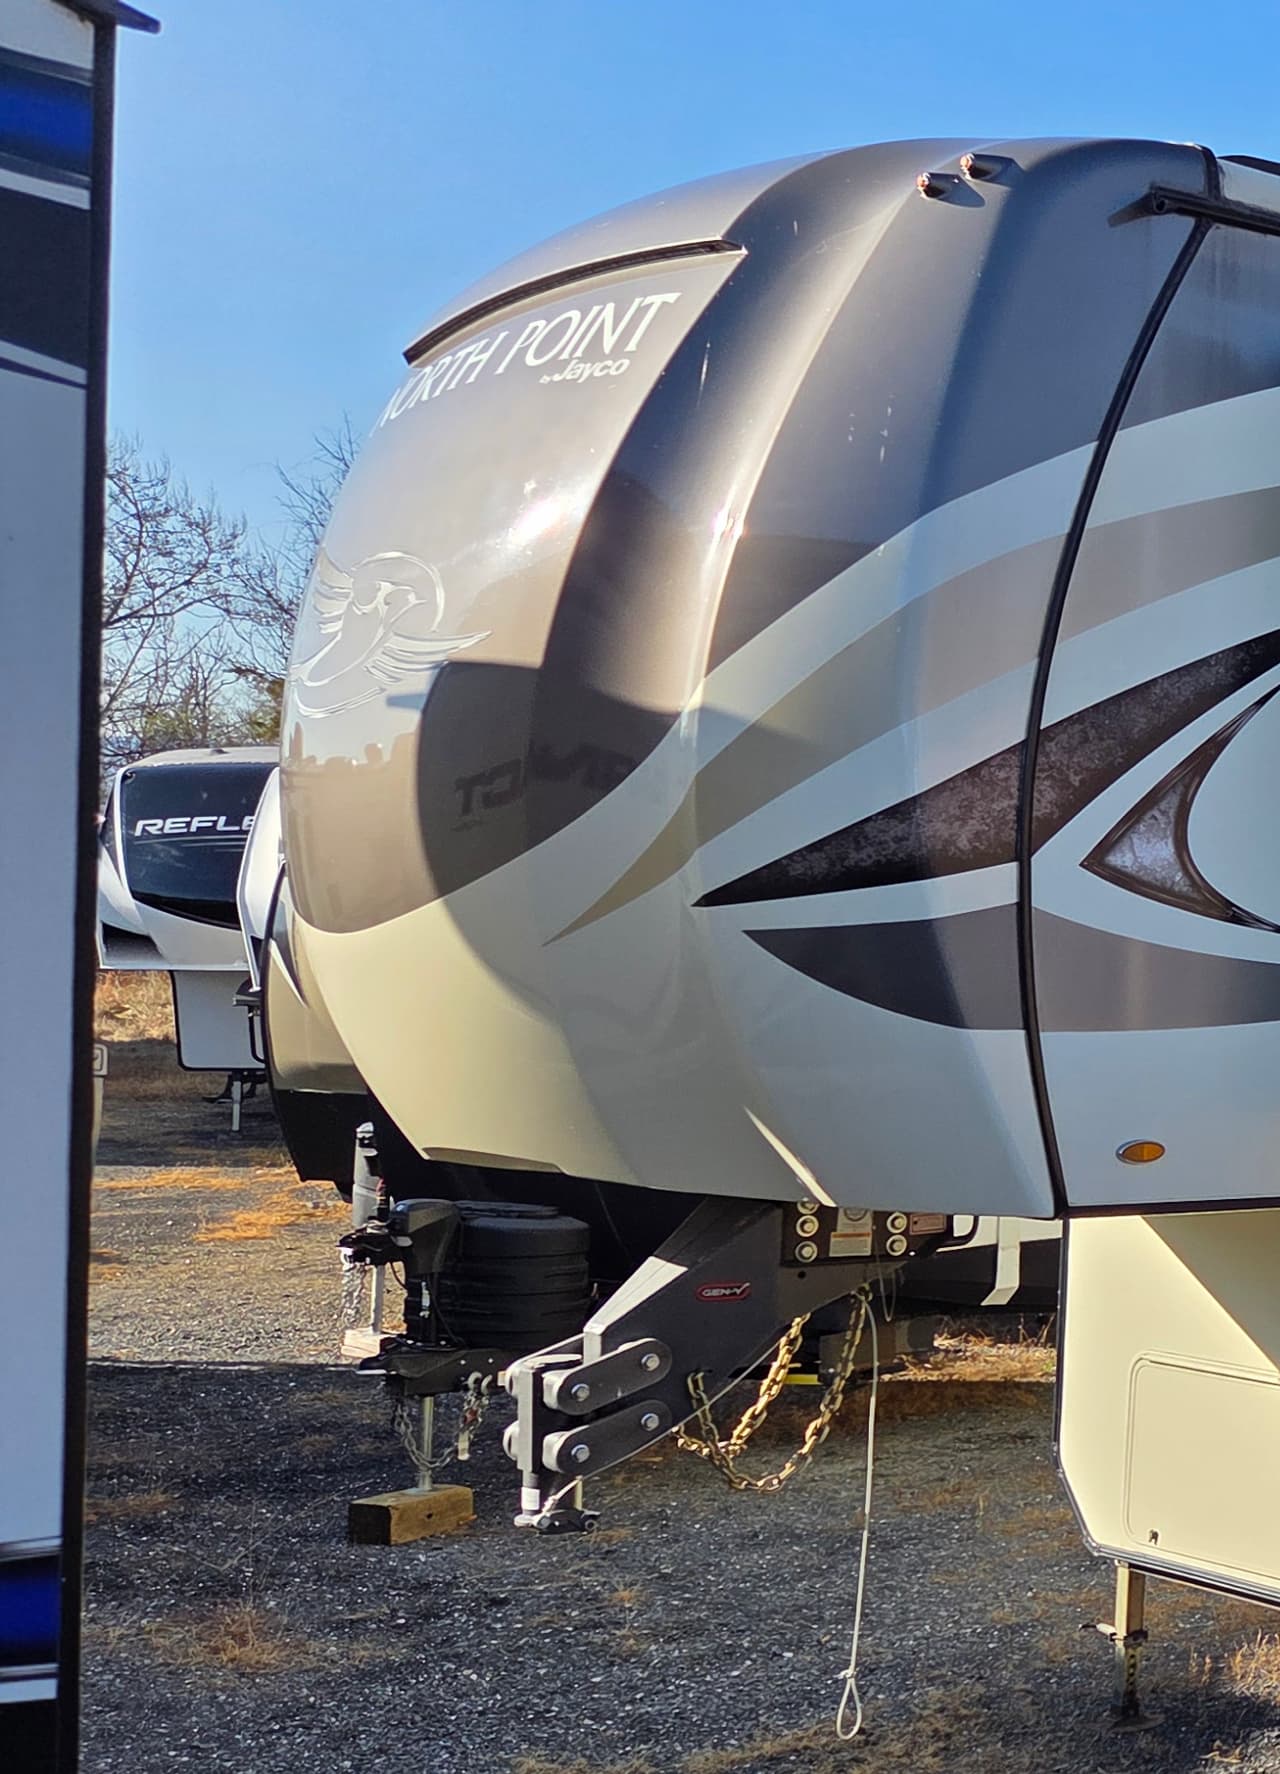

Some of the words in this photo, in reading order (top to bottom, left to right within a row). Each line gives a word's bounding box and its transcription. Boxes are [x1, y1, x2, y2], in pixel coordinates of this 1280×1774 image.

[369, 330, 509, 438] NORTH
[495, 292, 683, 375] POINT
[553, 357, 631, 384] Jayco
